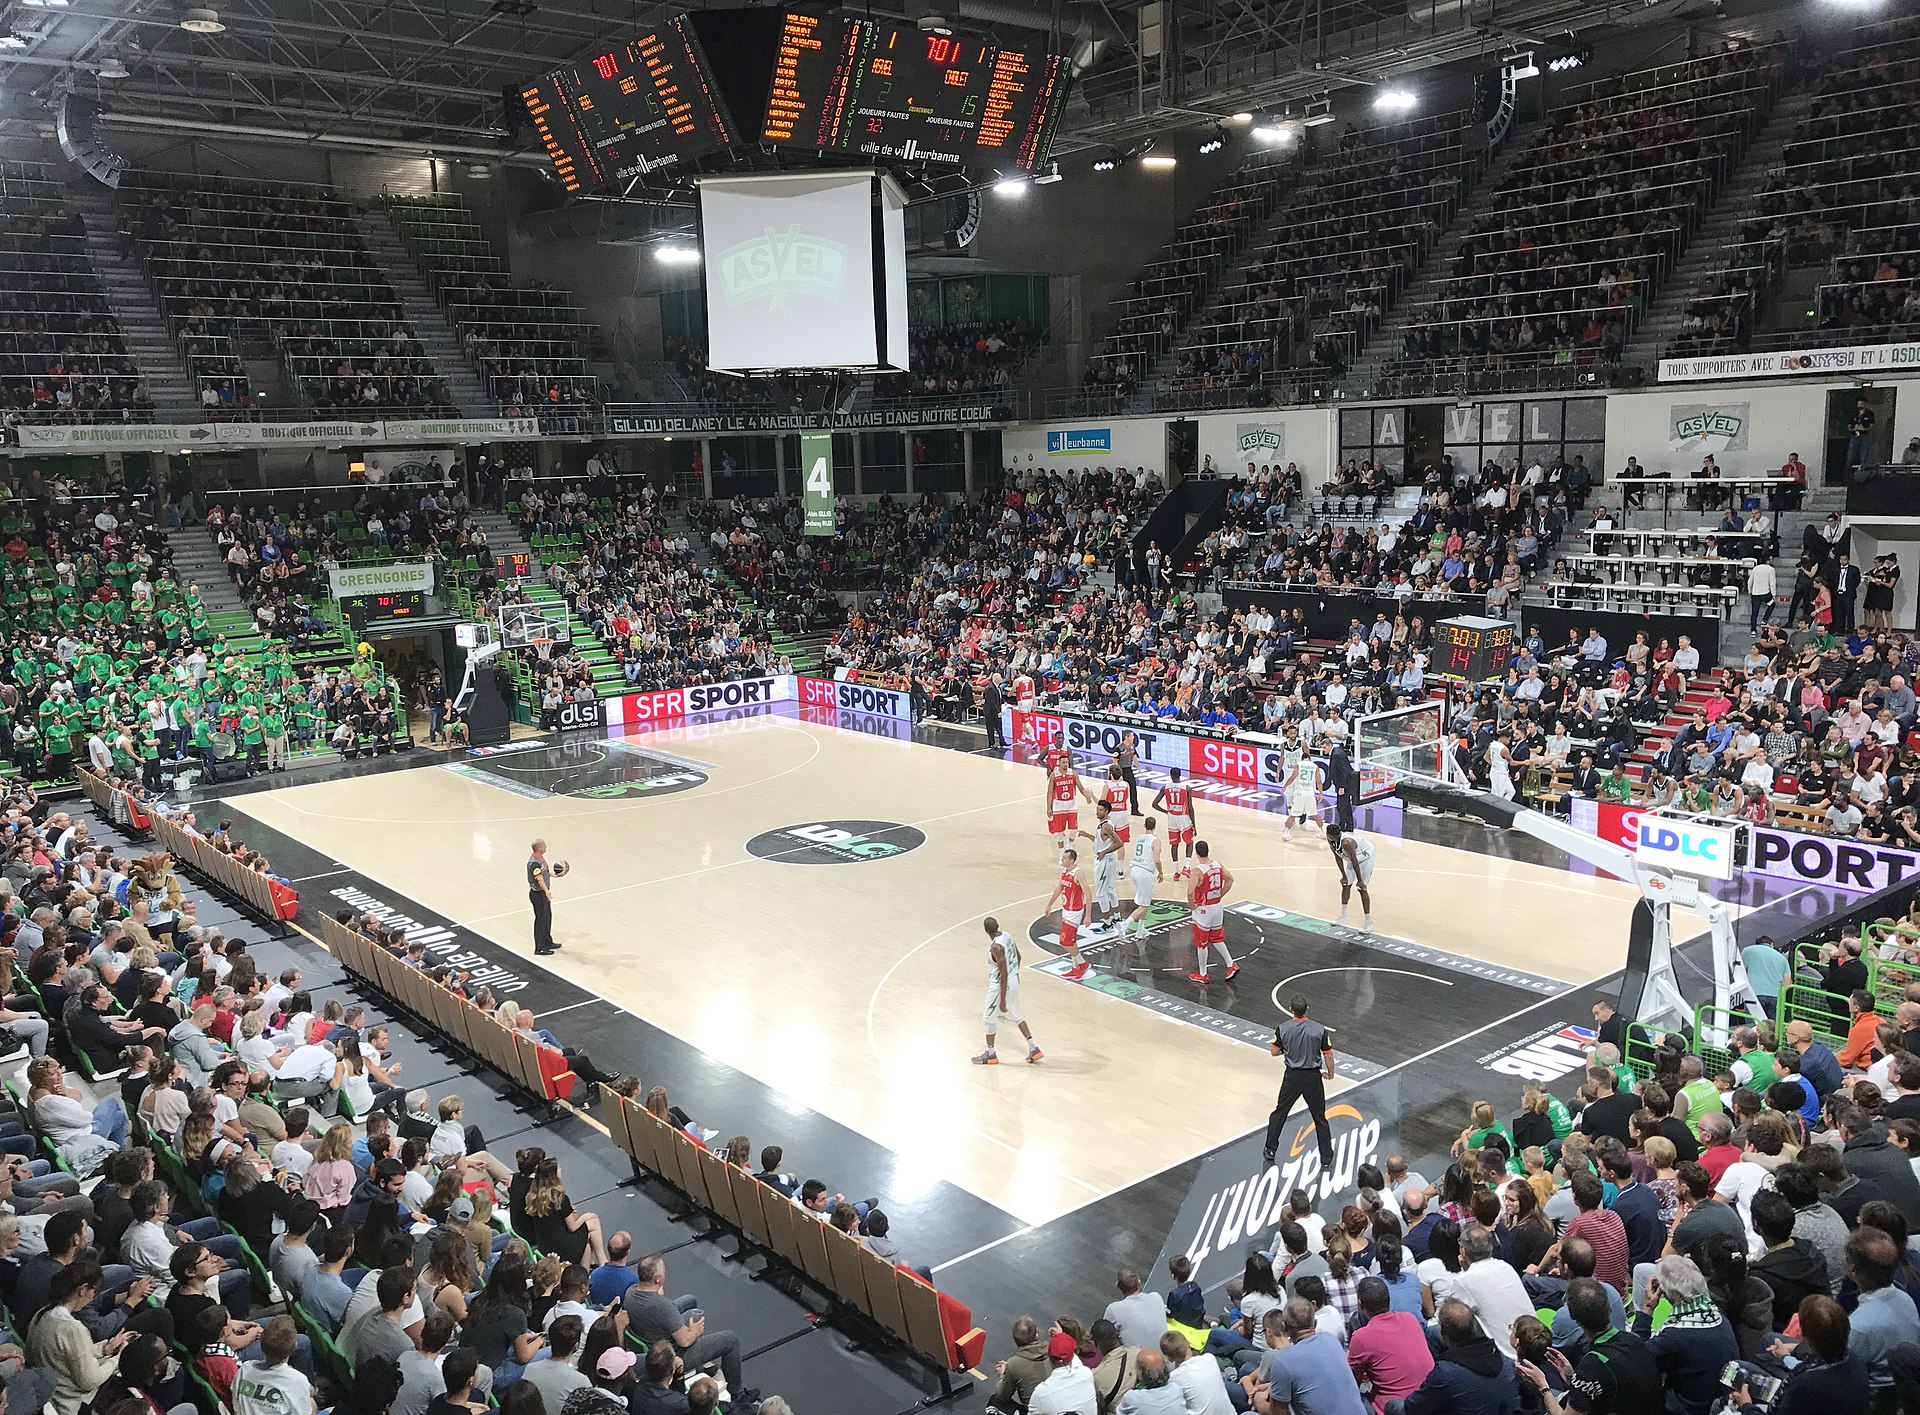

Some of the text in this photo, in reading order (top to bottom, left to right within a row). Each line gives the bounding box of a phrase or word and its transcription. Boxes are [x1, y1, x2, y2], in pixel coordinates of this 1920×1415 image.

[858, 108, 886, 117] JOUEURS
[887, 111, 910, 120] FAUTES
[925, 117, 975, 129] JOUEURS FAUTES
[860, 139, 960, 163] ville de villeurbanne
[616, 152, 679, 179] ville de villeurbanne
[734, 224, 833, 287] ASVEL
[1667, 363, 1689, 376] TOUS
[1692, 360, 1746, 374] SUPPORTERS
[1750, 358, 1774, 372] AVEC
[1861, 351, 1874, 364] ET
[421, 422, 461, 434] BOUTIQUE
[462, 421, 503, 433] OFFICIELLE
[614, 406, 993, 432] GILLOU DELANEY LE 4 MAGIQUE A JAMAIS DANS NOTRE COEUR
[1682, 412, 1735, 433] ASVEL
[71, 428, 179, 442] BOUTIQUE OFFICIELLE
[261, 425, 353, 438] BOUTIQUE OFFICIELLE
[1052, 432, 1105, 450] villeurbanne
[807, 457, 831, 499] 4
[338, 570, 425, 587] GREENGONES
[1450, 648, 1470, 671] 14
[636, 679, 774, 719] SFR SPORT
[805, 680, 899, 716] SFR SPORT
[560, 703, 599, 724] dlsi
[1203, 743, 1256, 780] SFR
[1300, 769, 1314, 781] 21
[1113, 791, 1124, 802] 18
[1169, 792, 1181, 804] 11
[1136, 844, 1144, 856] 9
[1640, 825, 1718, 861] LDLC
[1335, 930, 1558, 992] HIGH-TECH EXPERIENCE
[1141, 995, 1237, 1031] HIGH-TECH
[1491, 1034, 1597, 1082] LNB
[1185, 1118, 1381, 1280] amazon.fr
